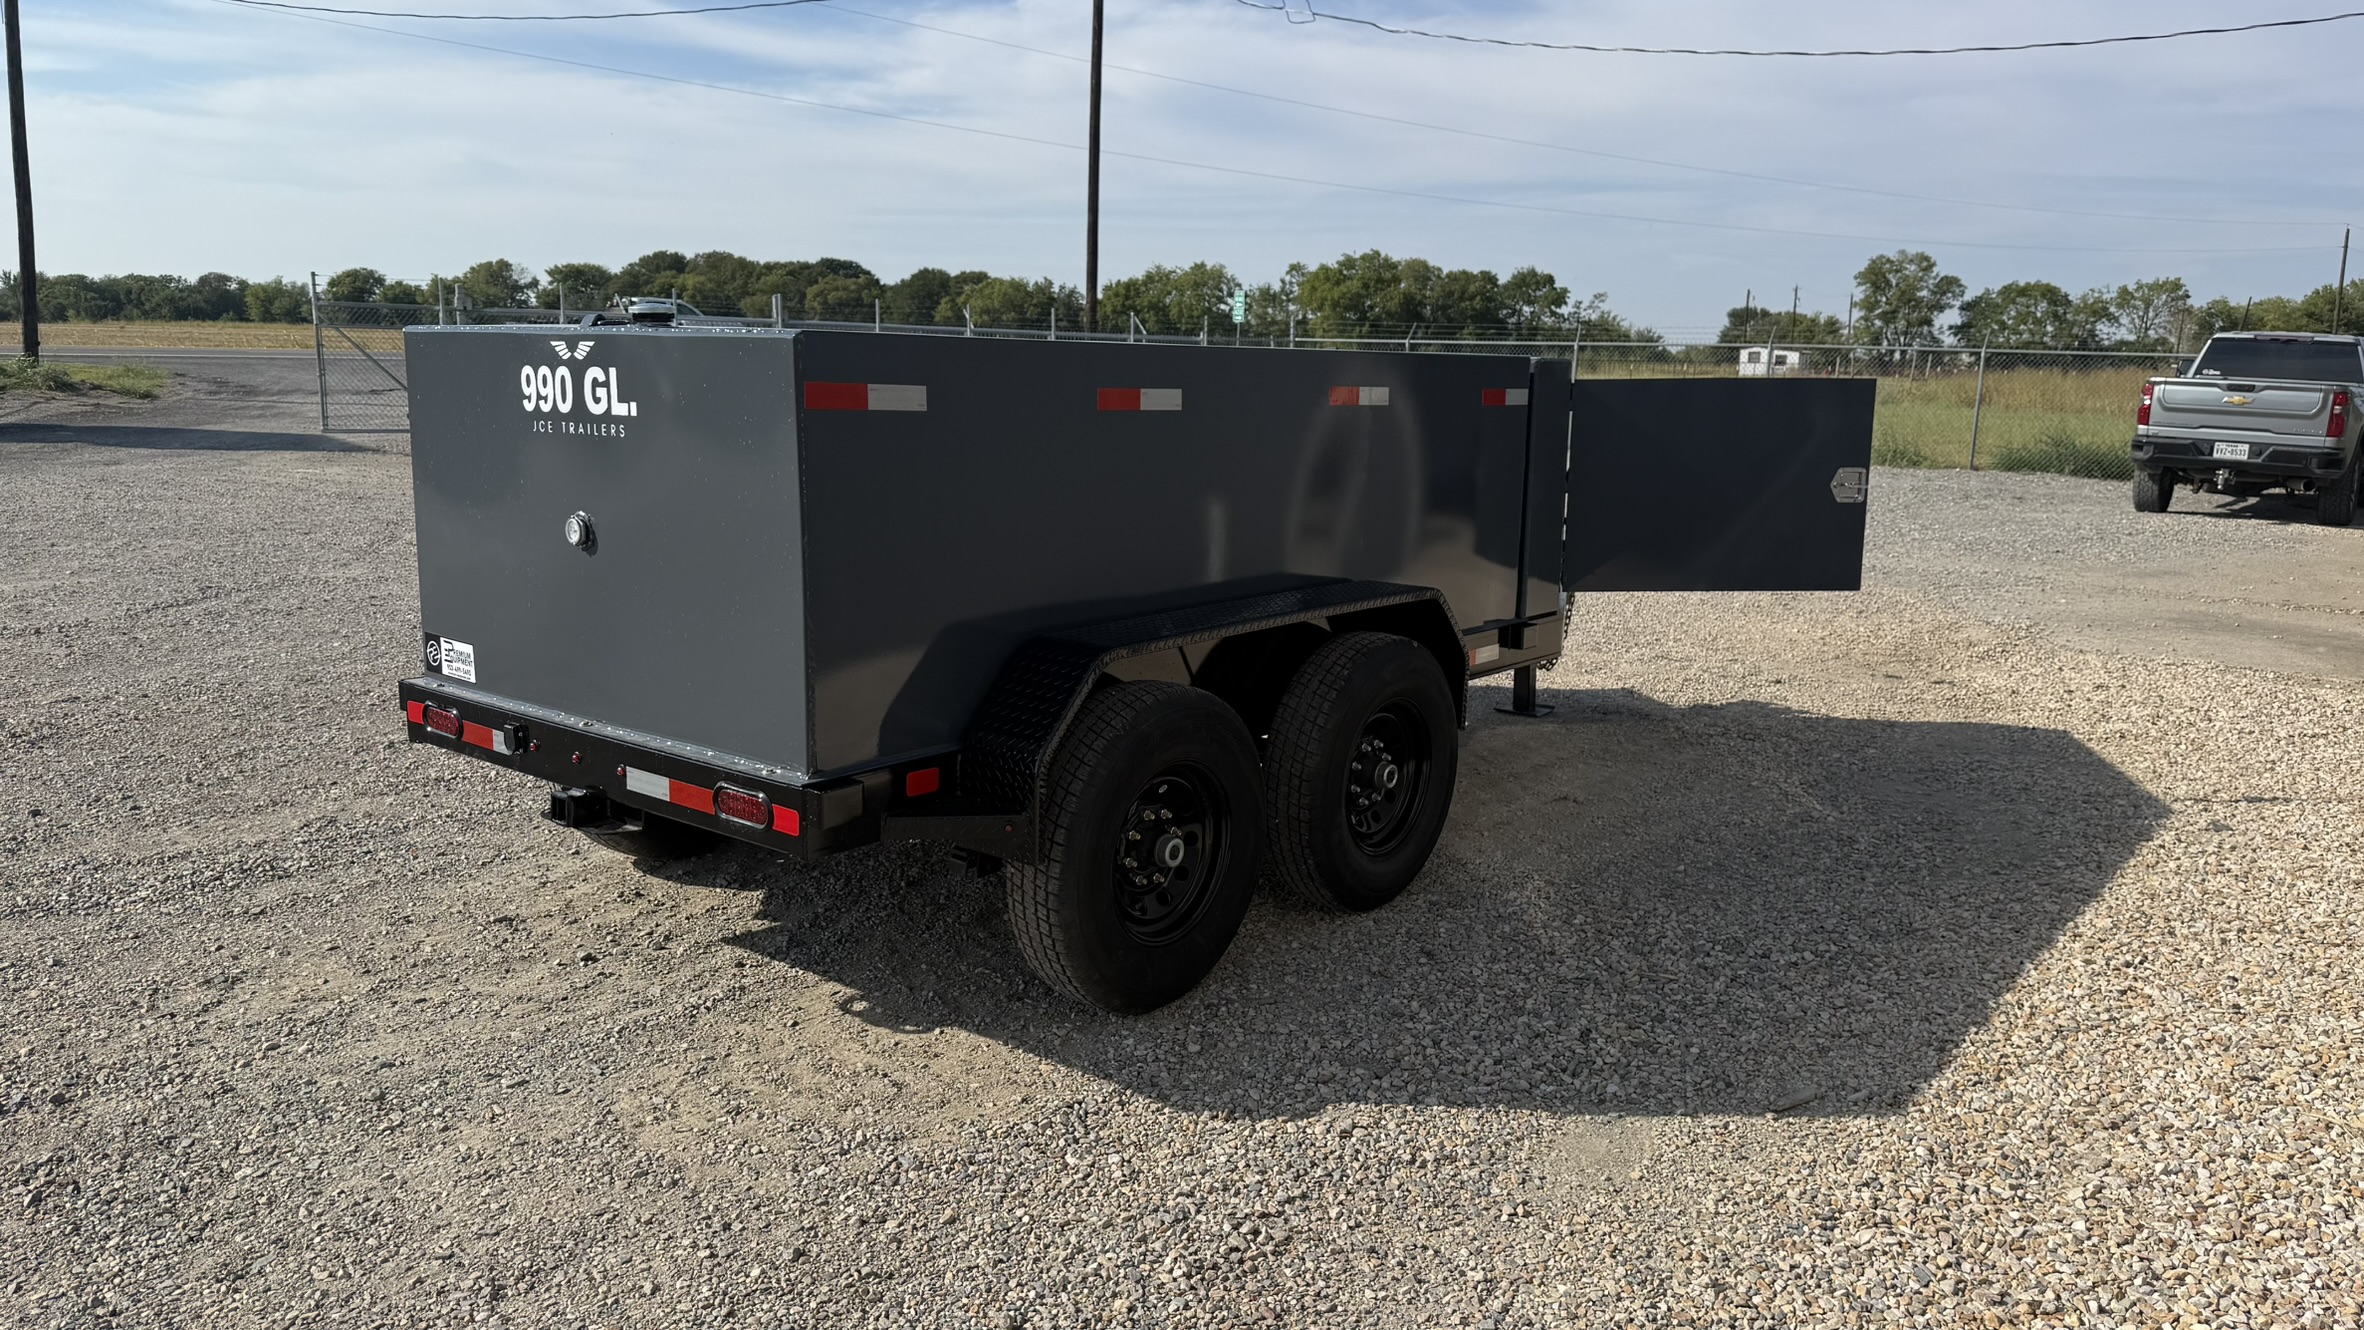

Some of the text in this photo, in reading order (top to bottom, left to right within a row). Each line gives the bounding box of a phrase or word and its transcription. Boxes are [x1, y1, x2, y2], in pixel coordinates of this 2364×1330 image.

[520, 364, 638, 417] 990 GL.
[532, 420, 626, 438] JCE TRAILERS
